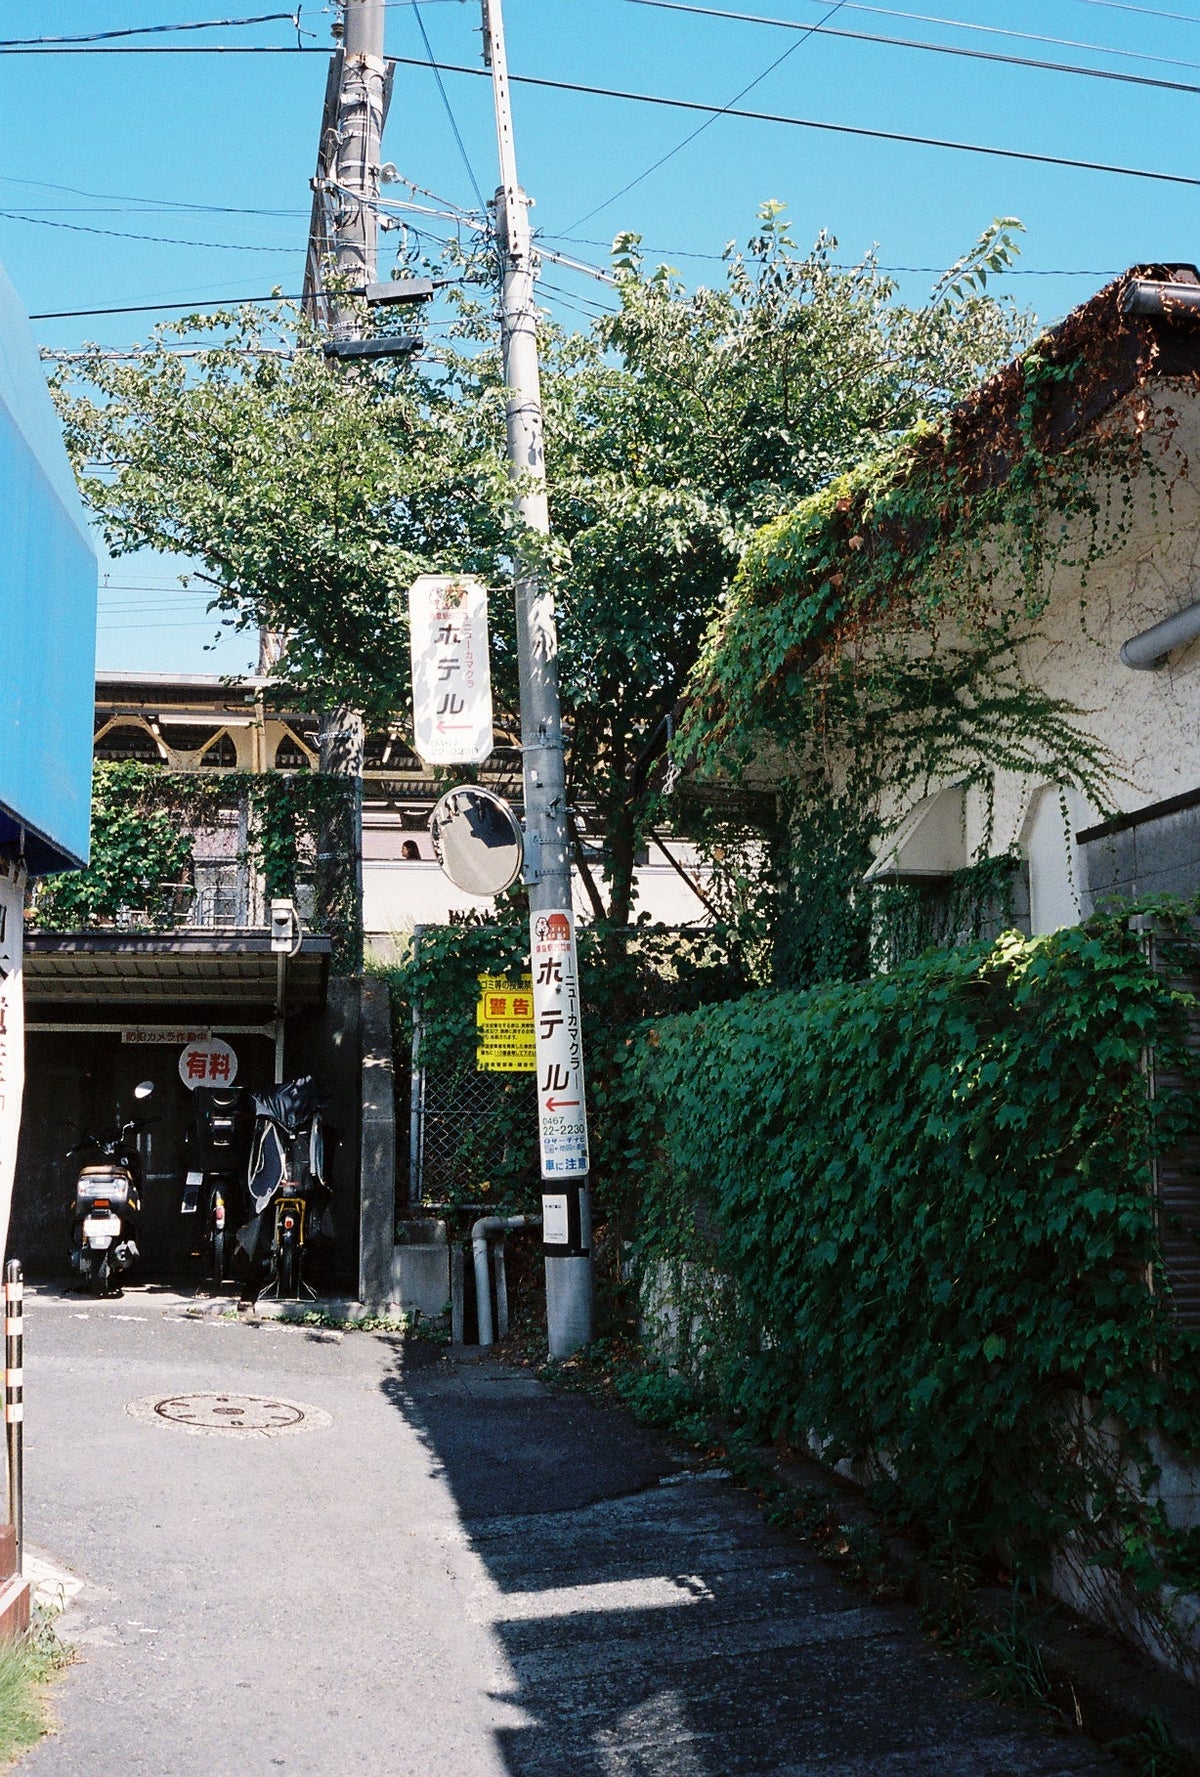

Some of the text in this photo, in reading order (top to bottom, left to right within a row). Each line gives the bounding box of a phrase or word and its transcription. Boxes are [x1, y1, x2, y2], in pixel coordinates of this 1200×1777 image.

[433, 624, 464, 715] ホテル
[490, 998, 529, 1015] 警告
[536, 957, 570, 1092] ホテル
[186, 1051, 231, 1081] 有料
[542, 1116, 565, 1125] 0467
[543, 1123, 585, 1136] 22-2230
[545, 1157, 587, 1171] 車に注意
